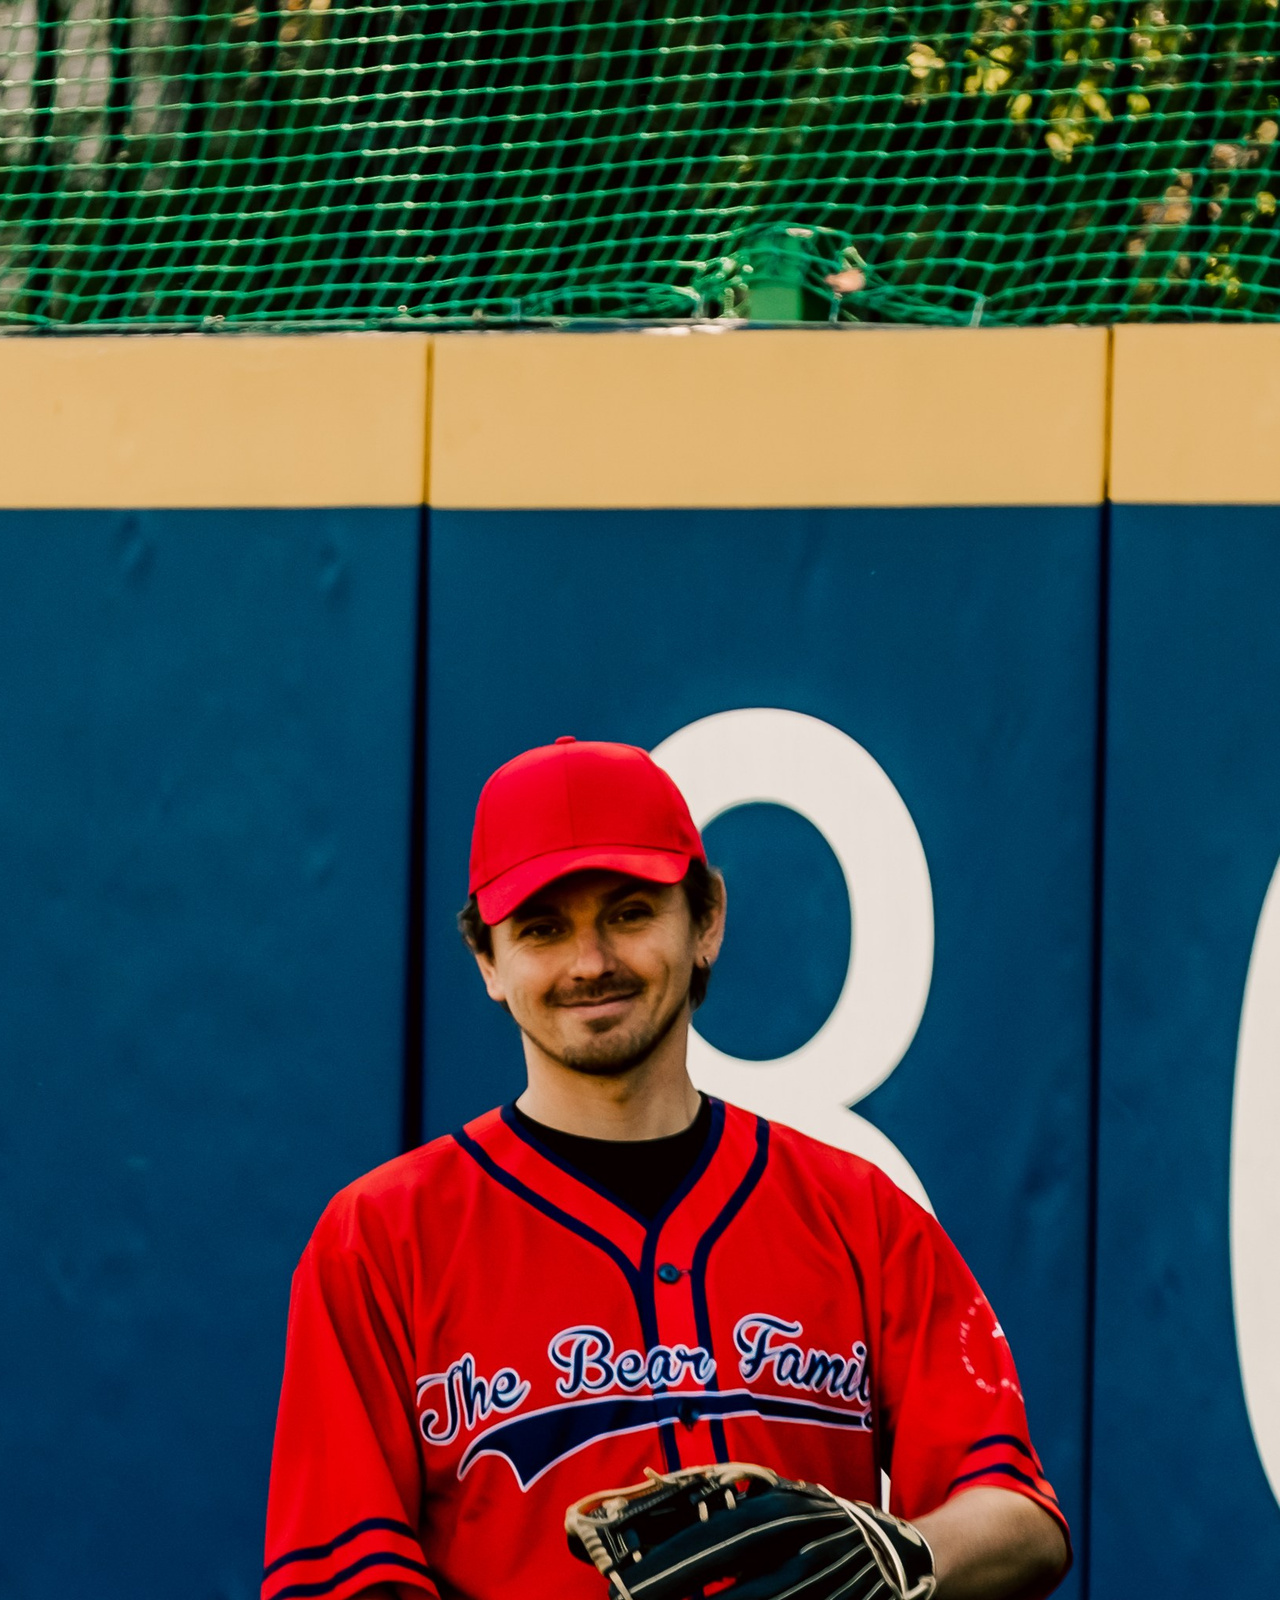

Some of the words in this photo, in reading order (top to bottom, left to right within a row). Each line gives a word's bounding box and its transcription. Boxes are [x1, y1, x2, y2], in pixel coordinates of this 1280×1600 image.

[416, 1352, 531, 1445] The
[548, 1325, 717, 1396] Bear
[733, 1313, 872, 1432] Famil
